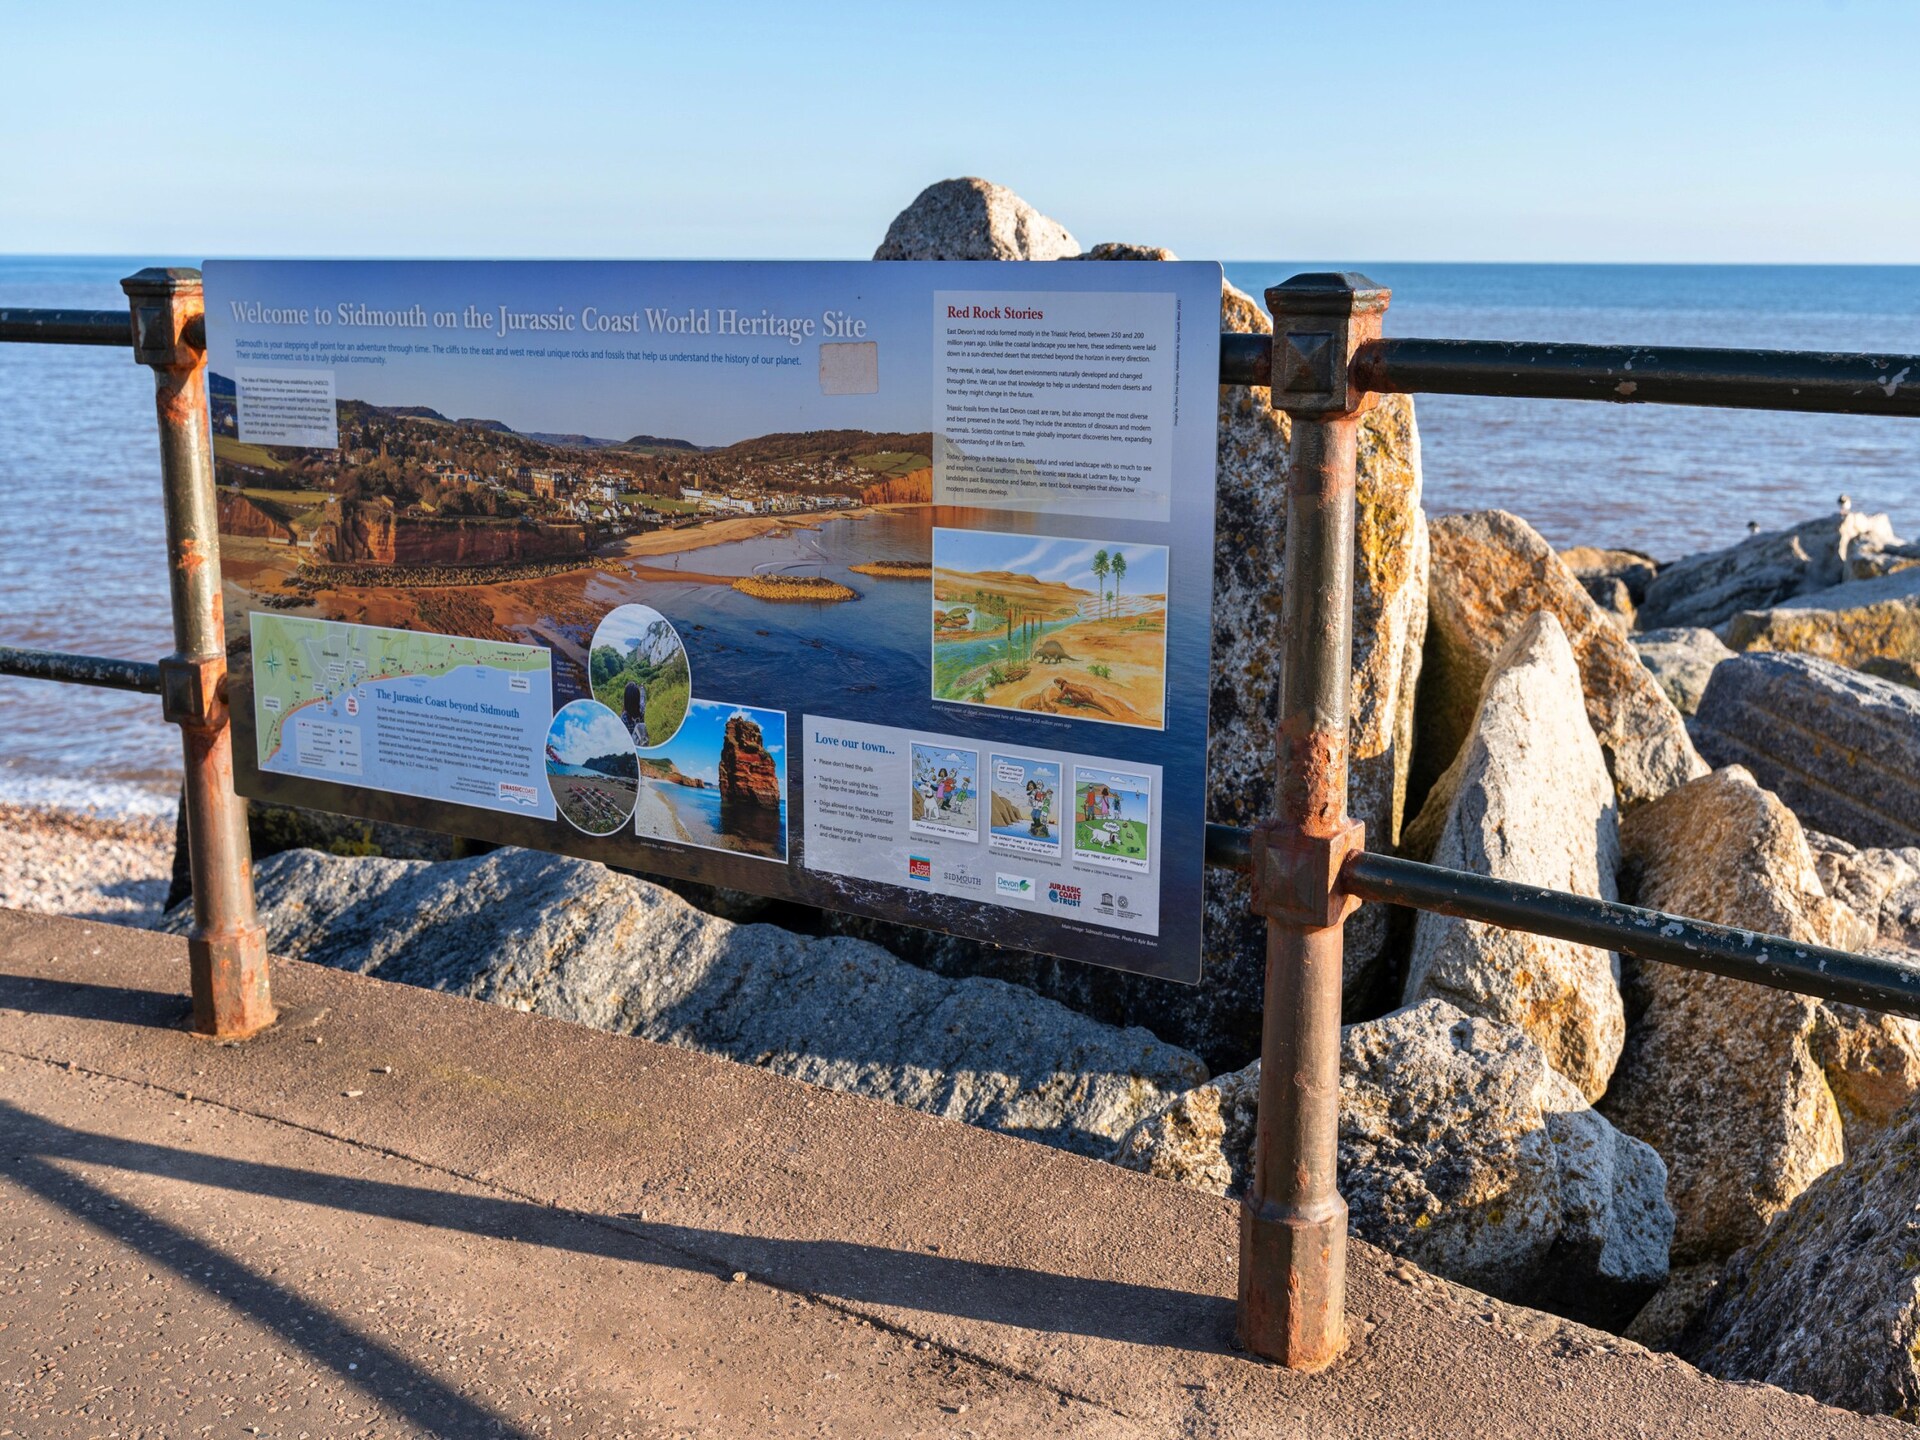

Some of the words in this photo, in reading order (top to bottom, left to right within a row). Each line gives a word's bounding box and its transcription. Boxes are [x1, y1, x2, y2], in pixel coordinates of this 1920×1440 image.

[948, 306, 969, 318] Red
[973, 306, 1000, 318] Rock
[1004, 307, 1043, 319] Stories
[230, 301, 308, 324] Welcome
[314, 306, 332, 325] to
[338, 303, 427, 328] Sidmouth
[434, 311, 458, 328] on
[464, 305, 493, 329] the
[498, 306, 575, 337] Jurassic
[582, 307, 640, 333] Coast
[645, 308, 710, 334] World
[718, 309, 815, 345] Heritage
[822, 311, 866, 337] Site
[1018, 330, 1034, 338] mostly
[1069, 330, 1086, 339] Period,
[1032, 341, 1055, 350] landscape
[1077, 342, 1089, 351] here,
[236, 339, 262, 348] Sidmouth
[264, 340, 268, 348] is
[270, 343, 282, 351] your
[284, 341, 309, 352] stepping
[320, 342, 335, 352] point
[337, 342, 345, 350] for
[357, 343, 386, 352] adventure
[388, 343, 413, 355] through
[415, 344, 431, 353] time.
[434, 345, 444, 354] The
[446, 345, 459, 354] cliffs
[461, 346, 468, 354] to
[470, 346, 480, 355] the
[482, 347, 494, 355] east
[496, 347, 508, 356] and
[510, 348, 524, 356] west
[526, 349, 546, 357] reveal
[547, 349, 570, 360] unique
[572, 350, 588, 358] rocks
[591, 350, 603, 358] and
[605, 350, 624, 359] fossils
[627, 351, 640, 360] that
[642, 351, 657, 363] help
[669, 353, 710, 362] understand
[711, 354, 723, 362] the
[725, 354, 749, 366] history
[752, 355, 758, 363] of
[776, 356, 801, 367] planet.
[237, 350, 250, 359] Their
[252, 351, 269, 359] stories
[271, 352, 293, 360] connect
[303, 353, 309, 361] to
[316, 353, 329, 364] truly
[331, 354, 349, 365] global
[351, 355, 386, 366] community.
[1005, 351, 1019, 359] desert
[1055, 353, 1074, 362] beyond
[376, 689, 391, 700] The
[393, 691, 423, 704] Jurassic
[425, 696, 447, 708] Coast
[450, 699, 478, 712] beyond
[481, 703, 519, 718] Sidmouth
[816, 732, 839, 745] Love
[842, 740, 859, 749] our
[862, 741, 895, 754] town...
[871, 816, 894, 824] September
[833, 826, 843, 834] keep
[911, 866, 930, 876] Devon
[917, 862, 930, 871] East
[944, 872, 981, 885] SIDMOUTH
[998, 877, 1018, 887] Devon
[1049, 882, 1081, 894] JURASSIC
[1059, 891, 1081, 900] COAST
[1059, 898, 1081, 907] TRUST
